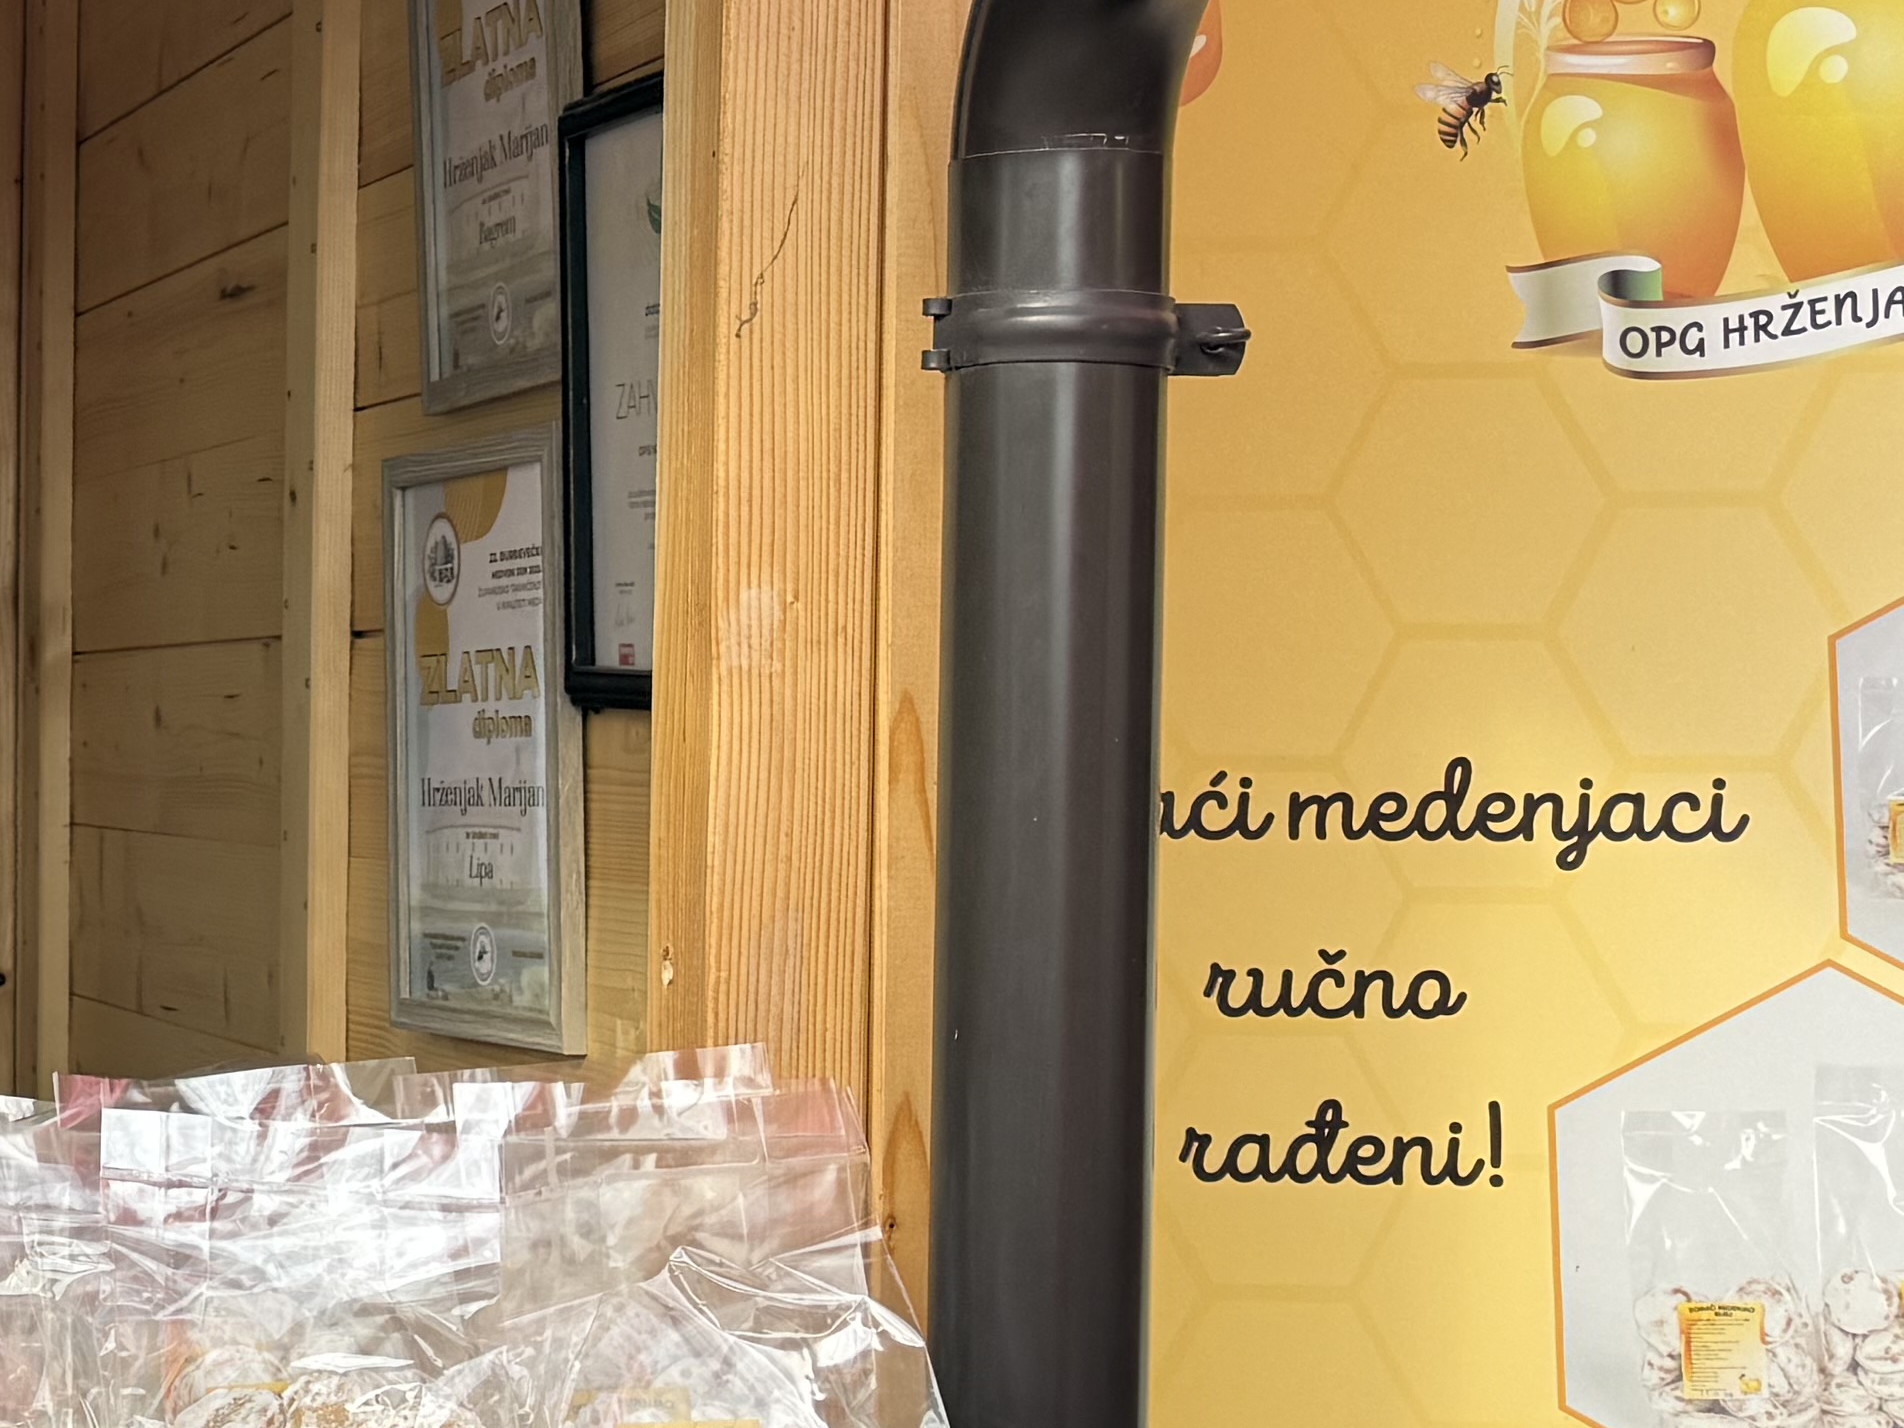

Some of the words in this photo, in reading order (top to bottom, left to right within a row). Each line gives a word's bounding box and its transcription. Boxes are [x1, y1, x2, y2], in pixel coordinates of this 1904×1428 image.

[1619, 320, 1706, 359] OPG
[418, 644, 541, 708] ZLATNA
[472, 709, 533, 746] diploma
[488, 776, 545, 816] Marijan
[1288, 756, 1749, 872] medenjaci
[1203, 948, 1468, 1020] ručno
[1178, 1098, 1505, 1189] rađeni!
